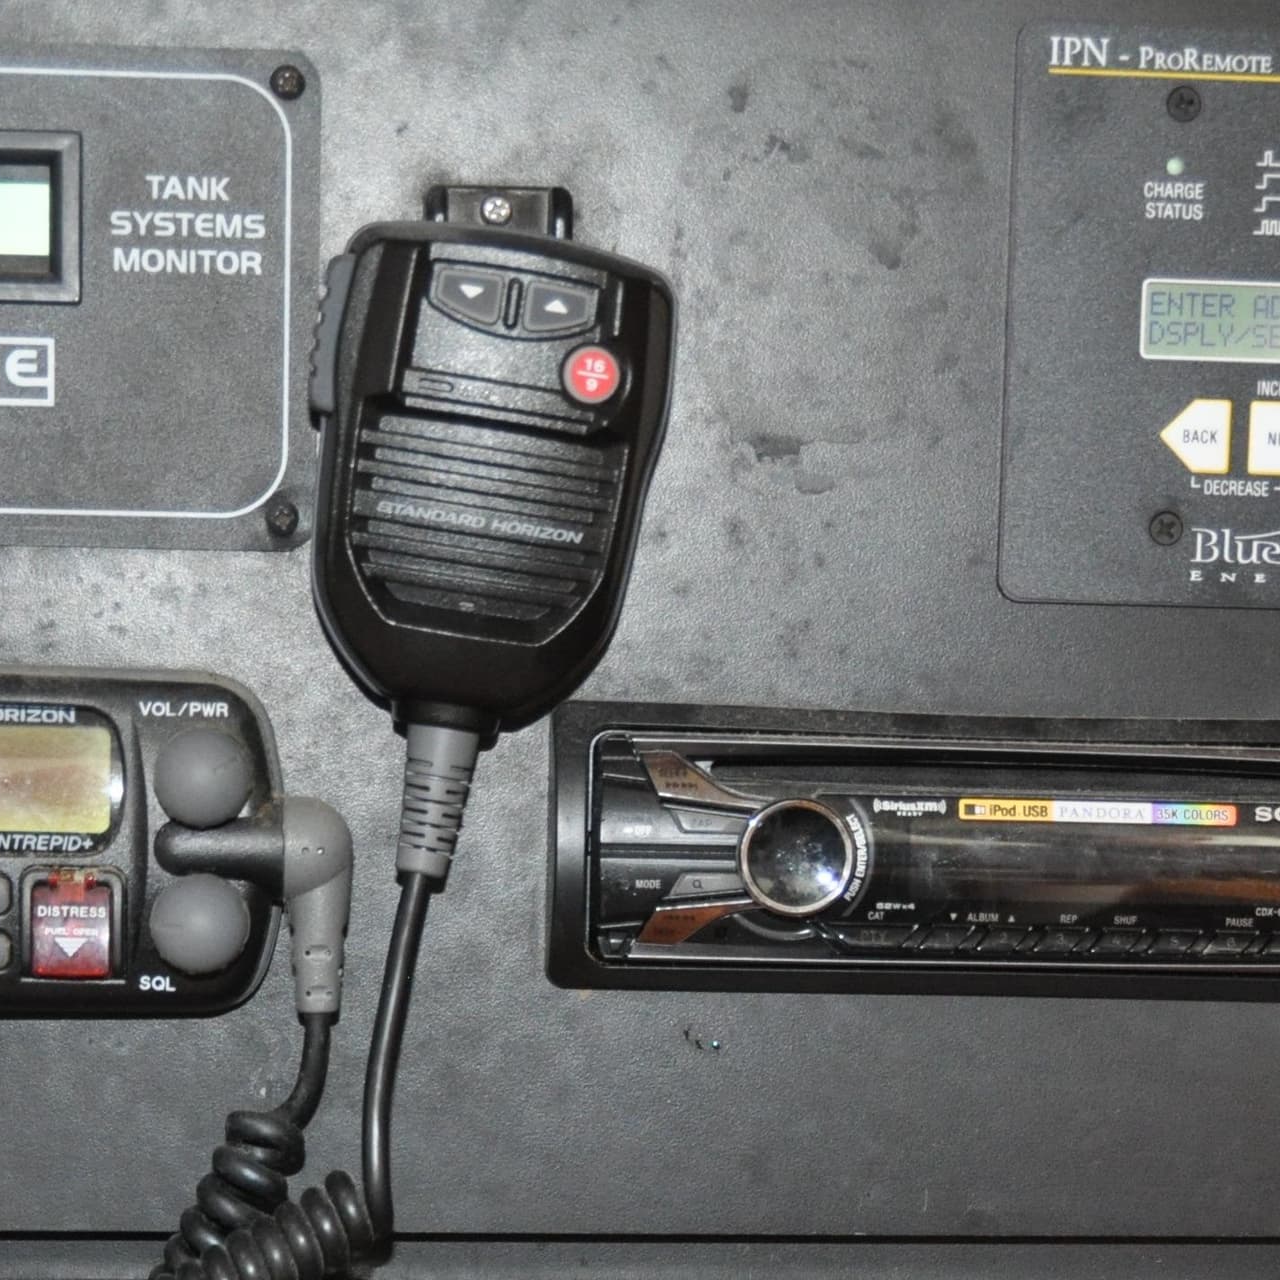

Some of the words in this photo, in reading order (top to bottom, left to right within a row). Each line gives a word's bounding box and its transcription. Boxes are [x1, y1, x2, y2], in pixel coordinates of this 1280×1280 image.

[1048, 36, 1111, 68] IPN
[145, 174, 230, 202] TANK
[1143, 181, 1205, 200] CHARGE
[1145, 201, 1204, 221] STATUS
[110, 210, 266, 240] SYSTEMS
[112, 246, 263, 276] MONITOR
[1150, 292, 1235, 319] ENTER
[583, 358, 606, 373] 16
[585, 378, 599, 392] 9
[1182, 429, 1217, 444] BACK
[1203, 479, 1270, 498] DECREASE
[376, 501, 486, 529] STANDARD
[491, 518, 584, 544] HORIZON
[139, 701, 230, 718] VOL/PWR
[987, 802, 1018, 821] iPod
[1021, 804, 1049, 821] USB
[1059, 807, 1145, 822] PANDORA
[1156, 808, 1178, 822] 35K
[1182, 808, 1230, 823] COLORS
[634, 878, 663, 890] MODE
[37, 905, 107, 920] DISTRESS
[967, 911, 1000, 923] ALBUM
[138, 975, 176, 992] SQL
